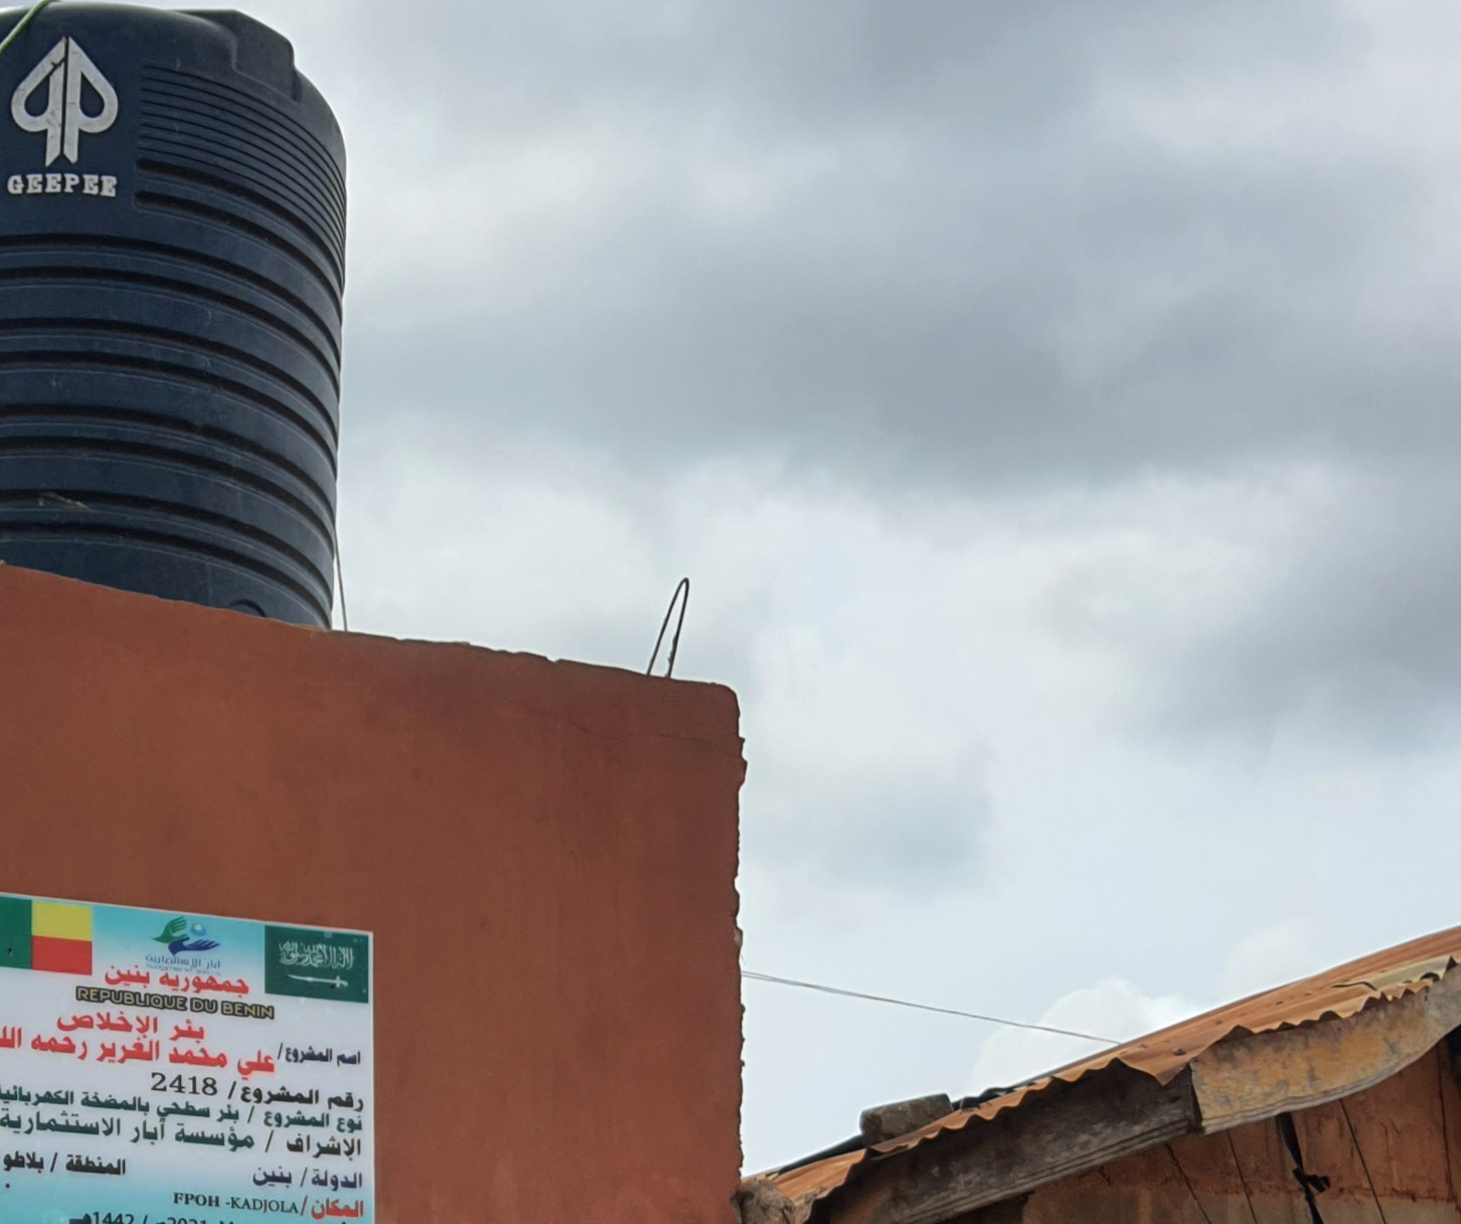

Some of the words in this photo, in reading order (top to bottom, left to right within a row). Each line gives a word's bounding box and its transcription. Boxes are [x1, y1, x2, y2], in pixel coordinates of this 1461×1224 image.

[7, 173, 118, 197] GEEPEE
[104, 965, 150, 989] بنين
[75, 986, 187, 1011] REPUBLIQUE
[190, 997, 218, 1014] DU
[220, 1001, 275, 1020] BENIN
[56, 1011, 158, 1039] الإخلاص
[169, 1019, 205, 1043] بئر
[31, 1034, 88, 1060] رحمه
[168, 1047, 227, 1068] محمد
[336, 1050, 361, 1067] اسم
[237, 1050, 275, 1080] علي
[150, 1072, 218, 1096] 2418
[80, 1091, 150, 1116] بالمضخة
[216, 1104, 240, 1124] بئر
[327, 1092, 364, 1113] رقم
[335, 1115, 363, 1133] نوع
[174, 1122, 255, 1152] مؤسسة
[285, 1133, 362, 1161] الإشراف
[2, 1150, 44, 1174] بلاطو
[65, 1154, 126, 1176] المنطقة
[252, 1166, 292, 1188] بنين
[172, 1192, 220, 1208] FPOH
